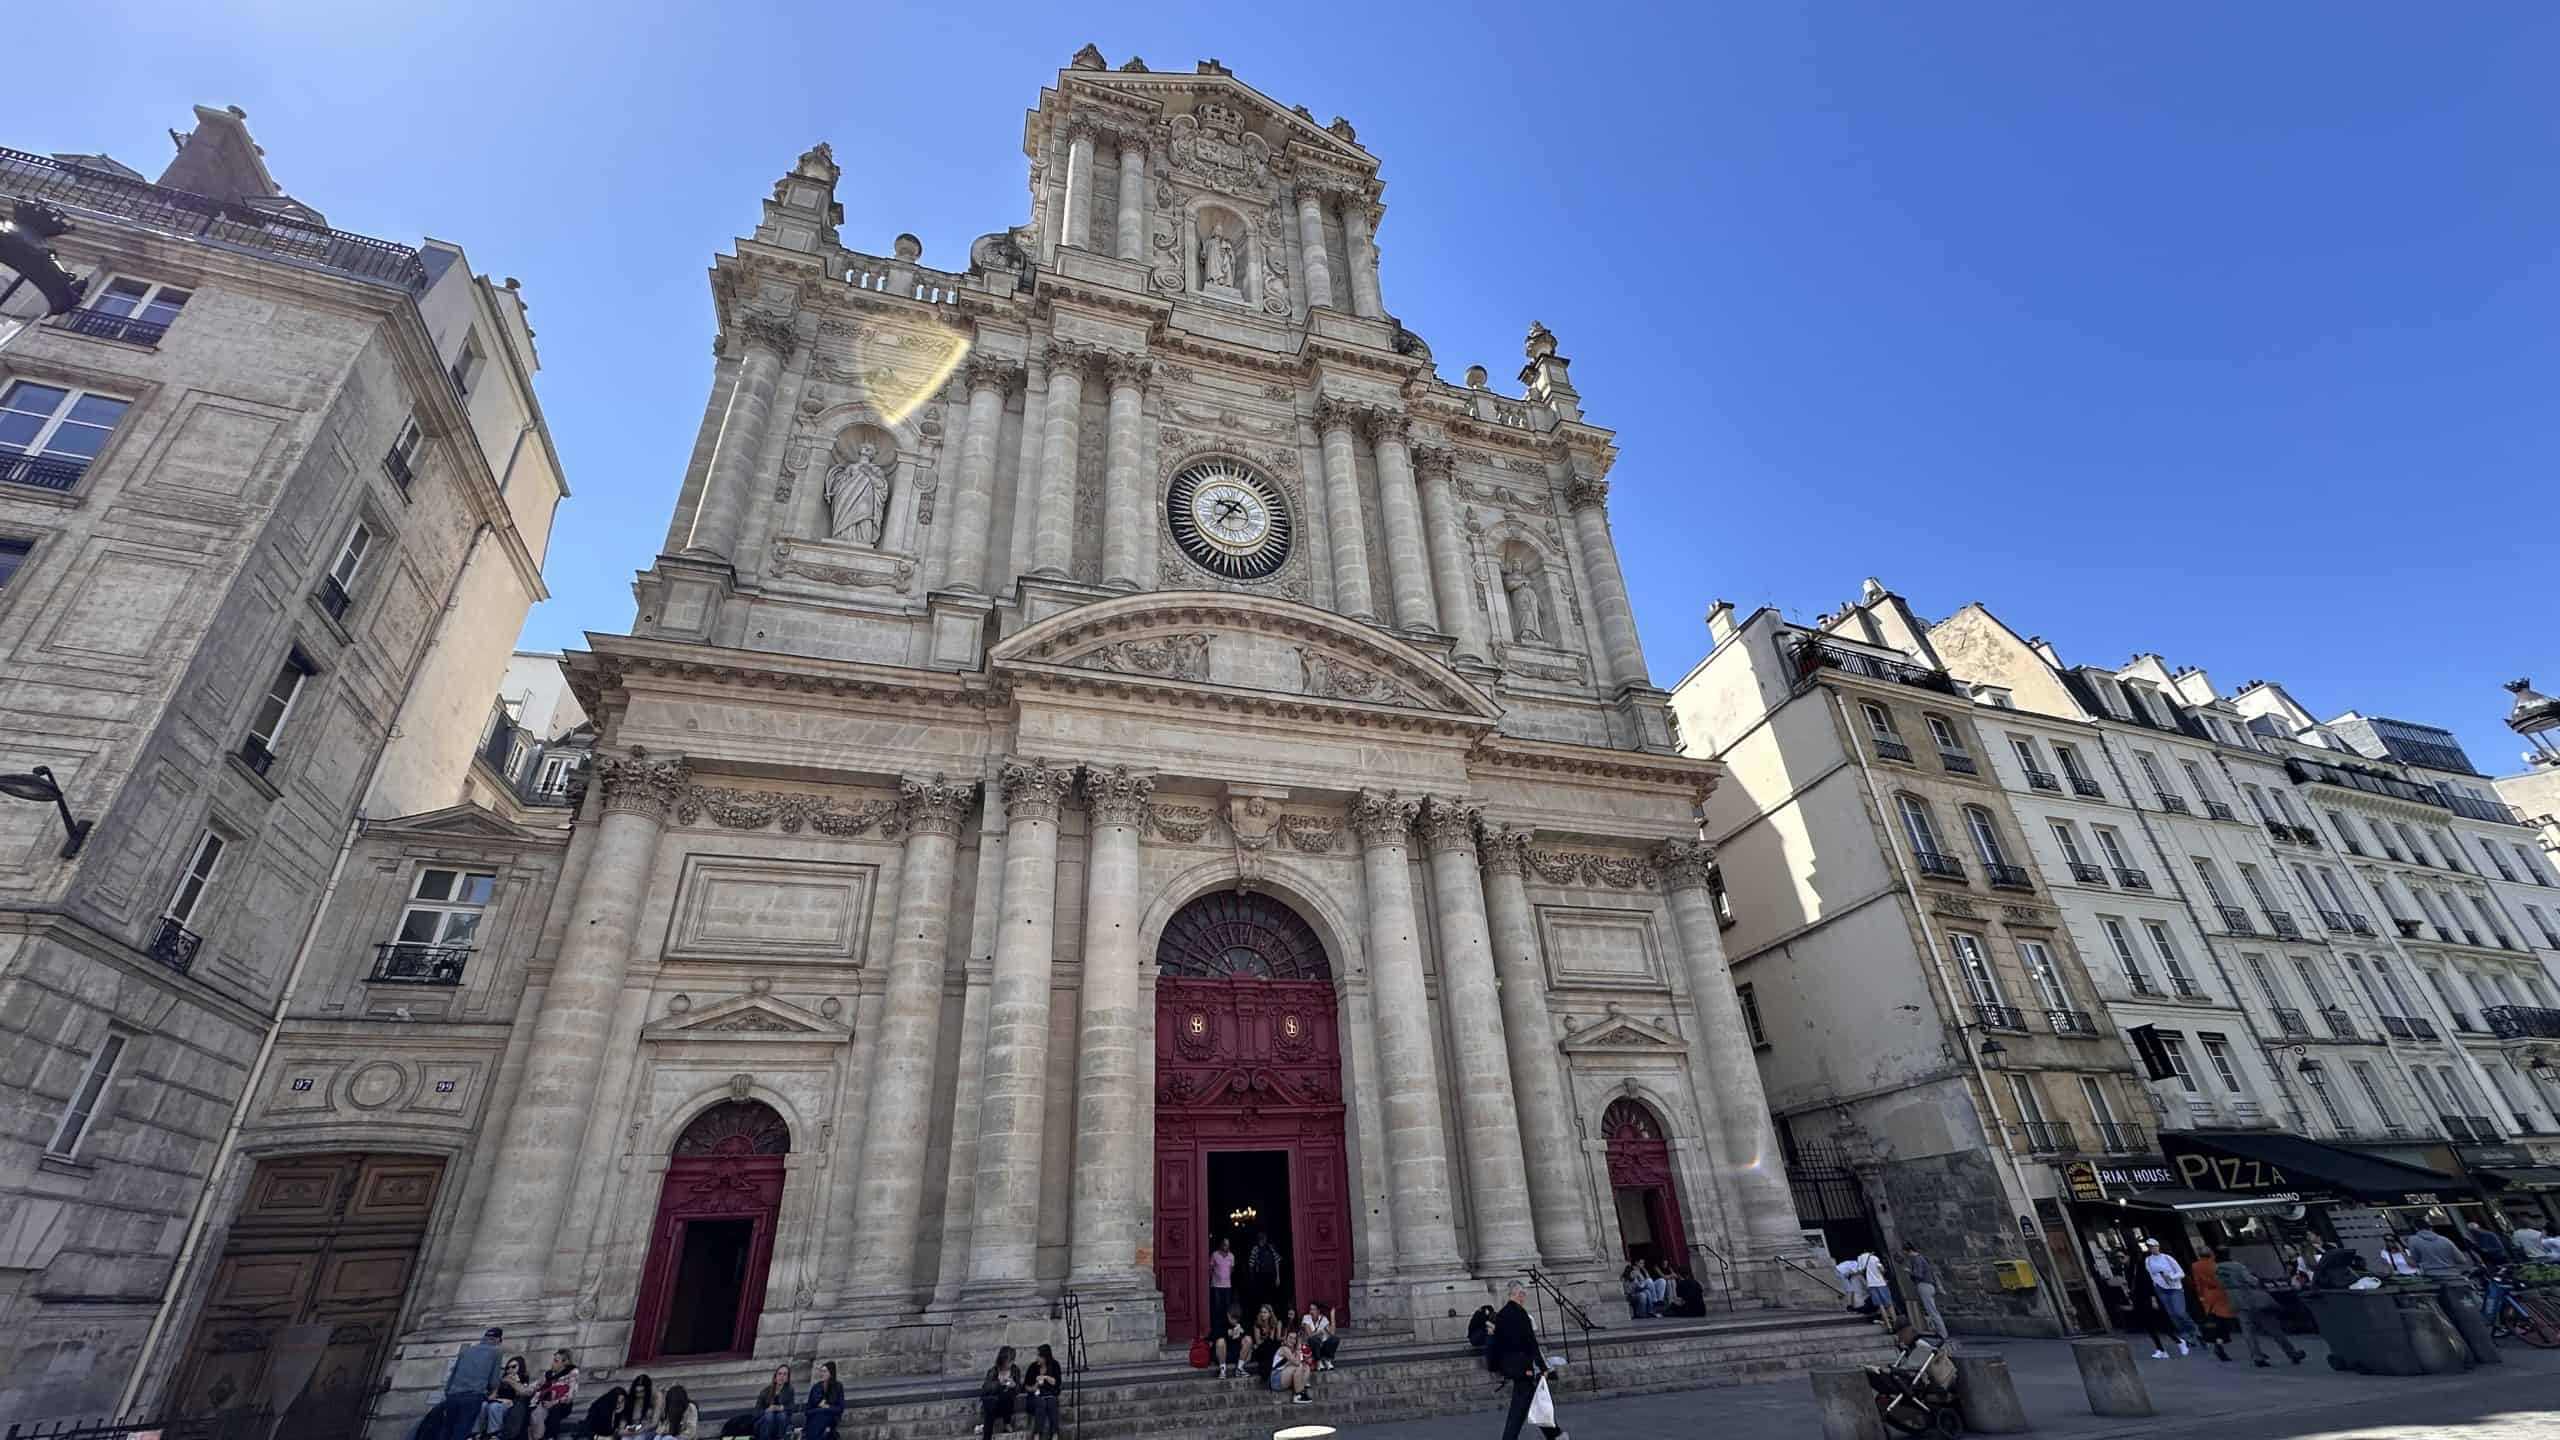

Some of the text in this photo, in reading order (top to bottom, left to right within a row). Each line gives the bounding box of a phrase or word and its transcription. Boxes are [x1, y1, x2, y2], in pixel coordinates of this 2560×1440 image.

[295, 1079, 312, 1090] 97
[438, 1081, 454, 1092] 99
[2098, 1169, 2132, 1184] ERIAL
[2133, 1168, 2174, 1183] HOUSE
[2176, 1154, 2286, 1190] PIZZA
